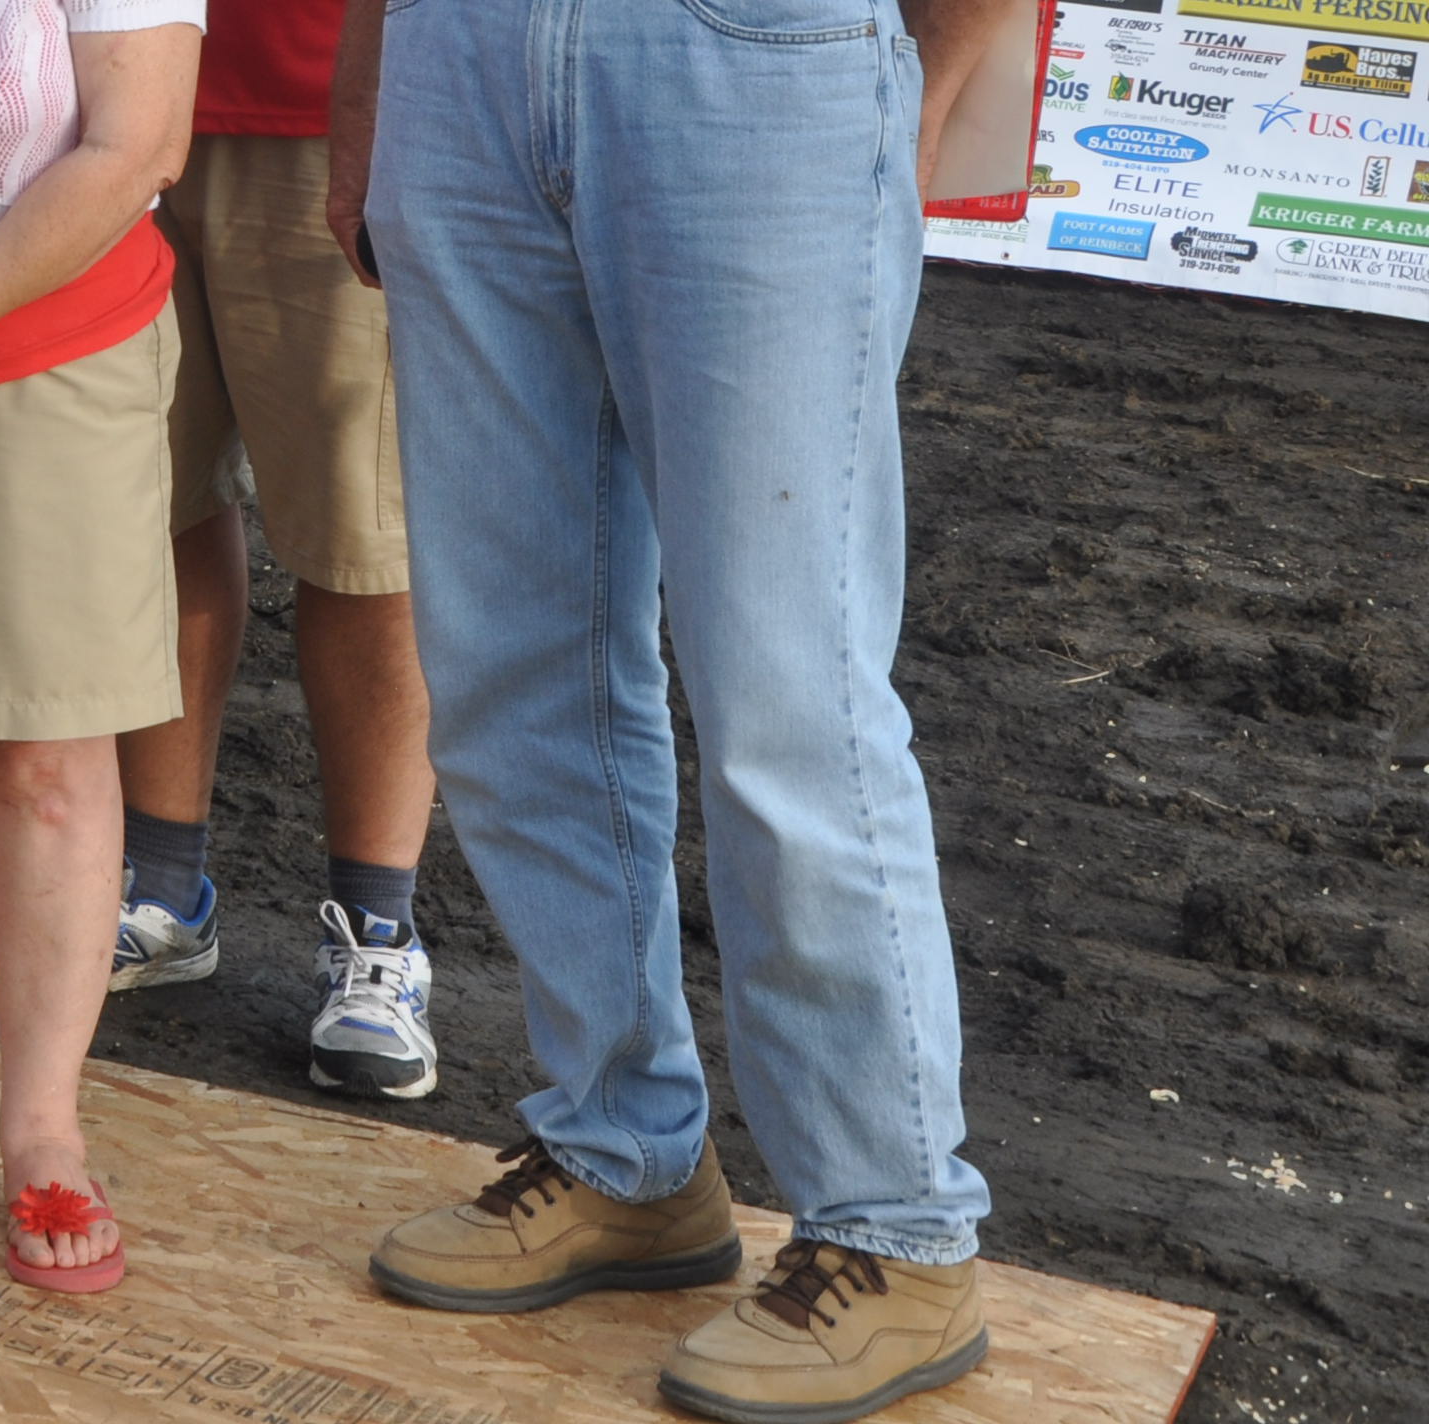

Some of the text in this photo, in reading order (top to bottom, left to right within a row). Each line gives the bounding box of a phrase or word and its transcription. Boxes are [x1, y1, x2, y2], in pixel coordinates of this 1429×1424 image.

[1182, 29, 1247, 48] TITAN
[1194, 47, 1284, 66] MACHINERY
[1358, 46, 1414, 67] Hayes
[1188, 61, 1269, 80] Grundy Center
[1355, 61, 1402, 80] Bros.
[1043, 78, 1090, 103] DUS
[1136, 78, 1235, 116] Kruger
[1201, 111, 1227, 120] SEEDS
[1308, 111, 1354, 140] U.S.
[1106, 127, 1182, 147] COOLEY
[1087, 135, 1197, 161] SANITATION
[1113, 173, 1204, 199] ELITE
[1223, 163, 1351, 189] MONSANTO
[1107, 198, 1215, 223] Insulation
[1256, 204, 1357, 230] KRUGER
[1098, 222, 1144, 236] FARMS
[1182, 226, 1237, 243] MIDWEST
[1059, 235, 1142, 253] OF REINBECK
[1178, 243, 1225, 263] SERVICE
[1318, 239, 1429, 266] GREEN BELT
[1314, 254, 1362, 274] BANK
[1366, 260, 1384, 276] &
